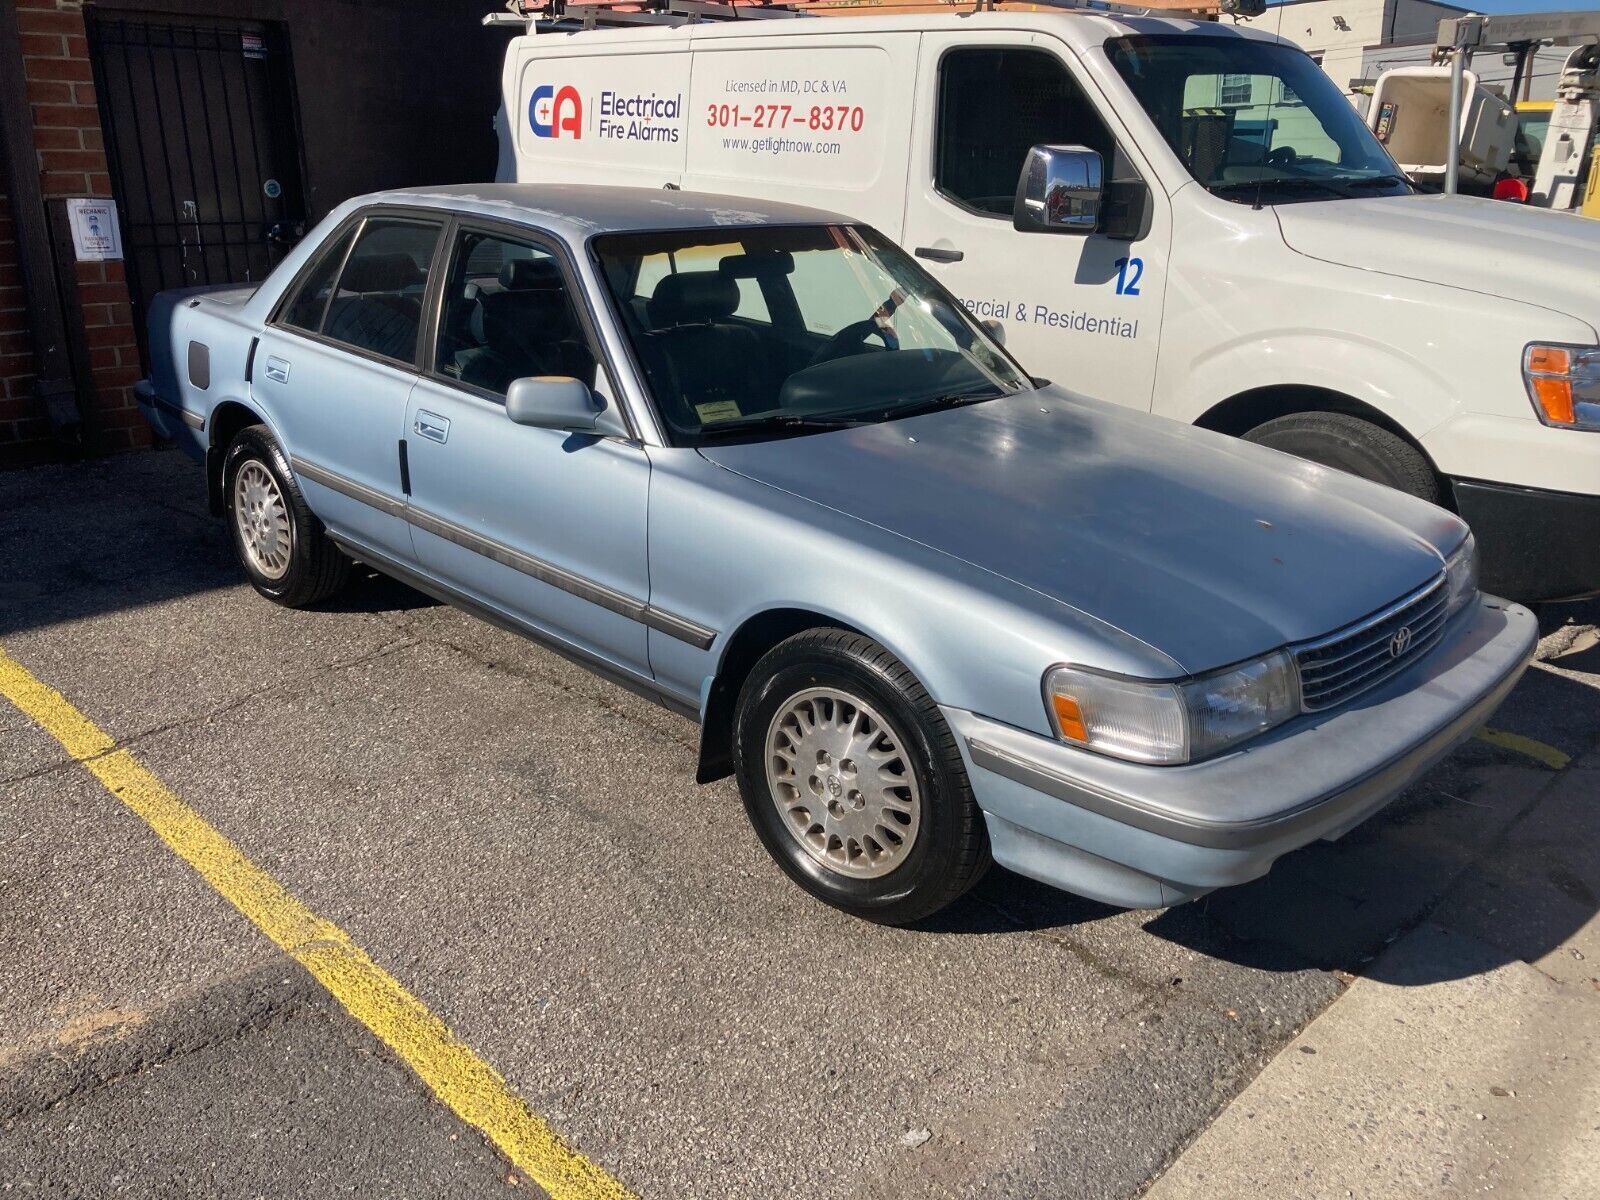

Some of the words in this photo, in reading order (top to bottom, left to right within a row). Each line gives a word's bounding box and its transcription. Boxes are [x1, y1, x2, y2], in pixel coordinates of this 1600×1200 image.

[725, 79, 767, 93] Licensed
[769, 80, 778, 93] in
[780, 80, 801, 95] MD,
[804, 80, 819, 93] DC
[820, 80, 829, 93] &
[832, 80, 847, 93] VA
[600, 91, 682, 119] Electrical
[706, 103, 865, 132] 301-277-8370
[600, 119, 625, 139] Fire
[626, 120, 680, 143] Alarms
[722, 136, 841, 155] www.getlightnow.com
[1114, 256, 1144, 296] 12
[1015, 303, 1027, 322] &
[1034, 305, 1139, 339] Residential
